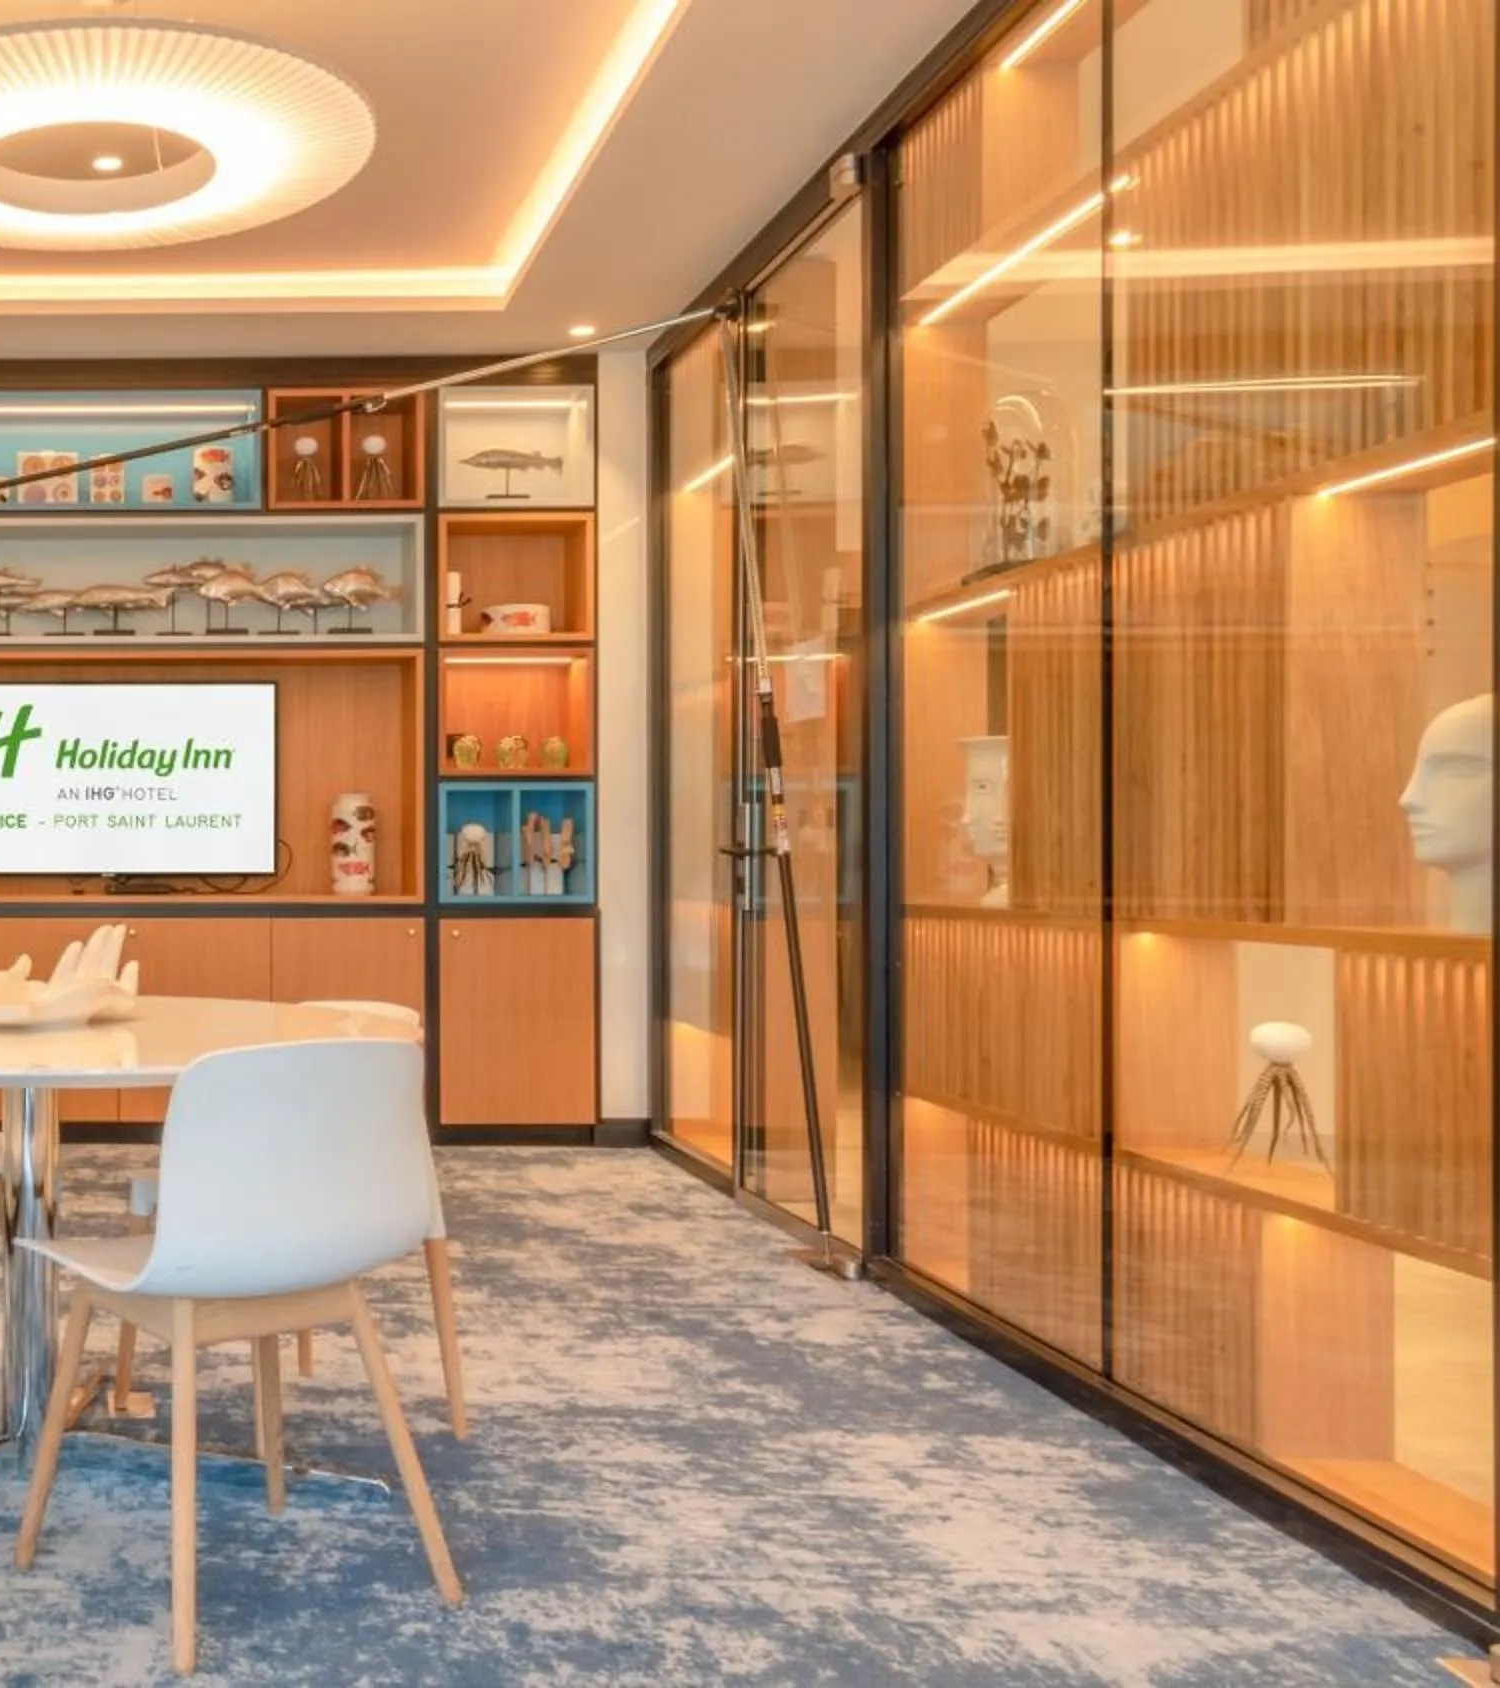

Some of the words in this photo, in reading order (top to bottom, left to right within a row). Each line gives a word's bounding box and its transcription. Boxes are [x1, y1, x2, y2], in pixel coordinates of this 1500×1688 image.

[55, 738, 177, 777] Holiday
[182, 737, 232, 770] Inn
[57, 786, 80, 801] AN
[121, 786, 178, 801] HOTEL
[53, 814, 99, 829] PORT
[106, 814, 157, 829] SAINT
[165, 814, 243, 829] LAURENT
